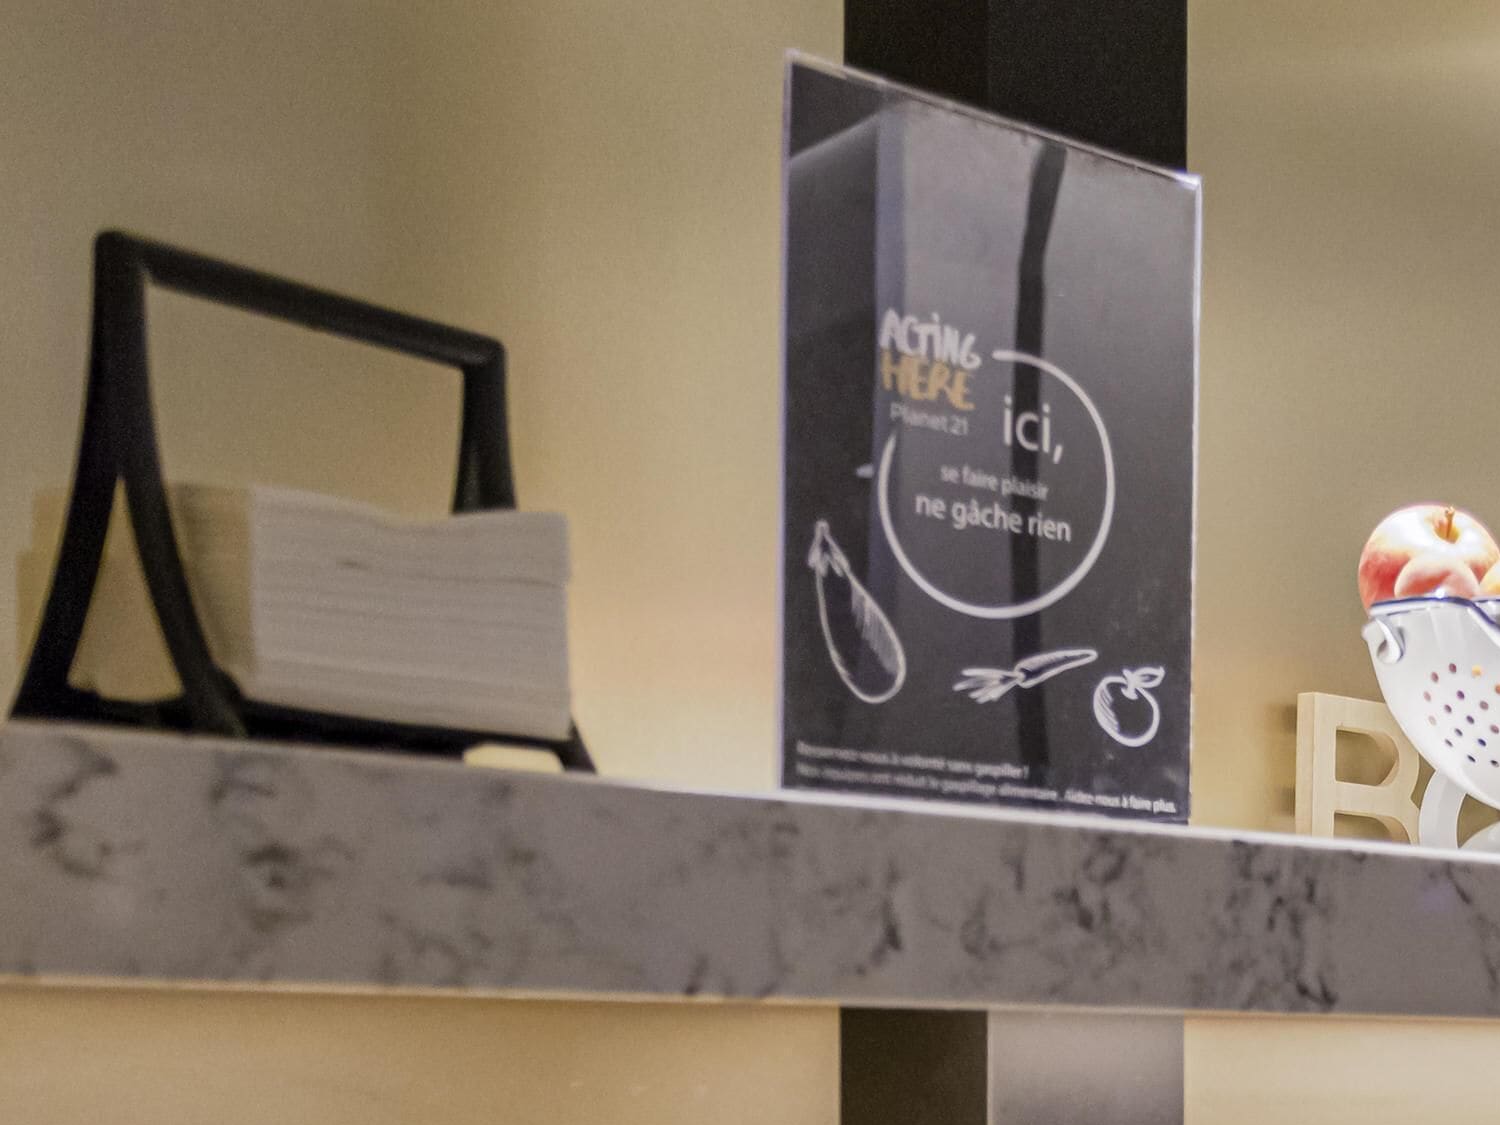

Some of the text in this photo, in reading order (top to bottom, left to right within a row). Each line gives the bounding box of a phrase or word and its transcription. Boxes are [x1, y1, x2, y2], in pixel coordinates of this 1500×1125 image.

[880, 346, 977, 411] HERE
[890, 402, 947, 434] Planet
[940, 465, 1049, 501] se faire plaisir
[915, 493, 1071, 542] ne gâche rien
